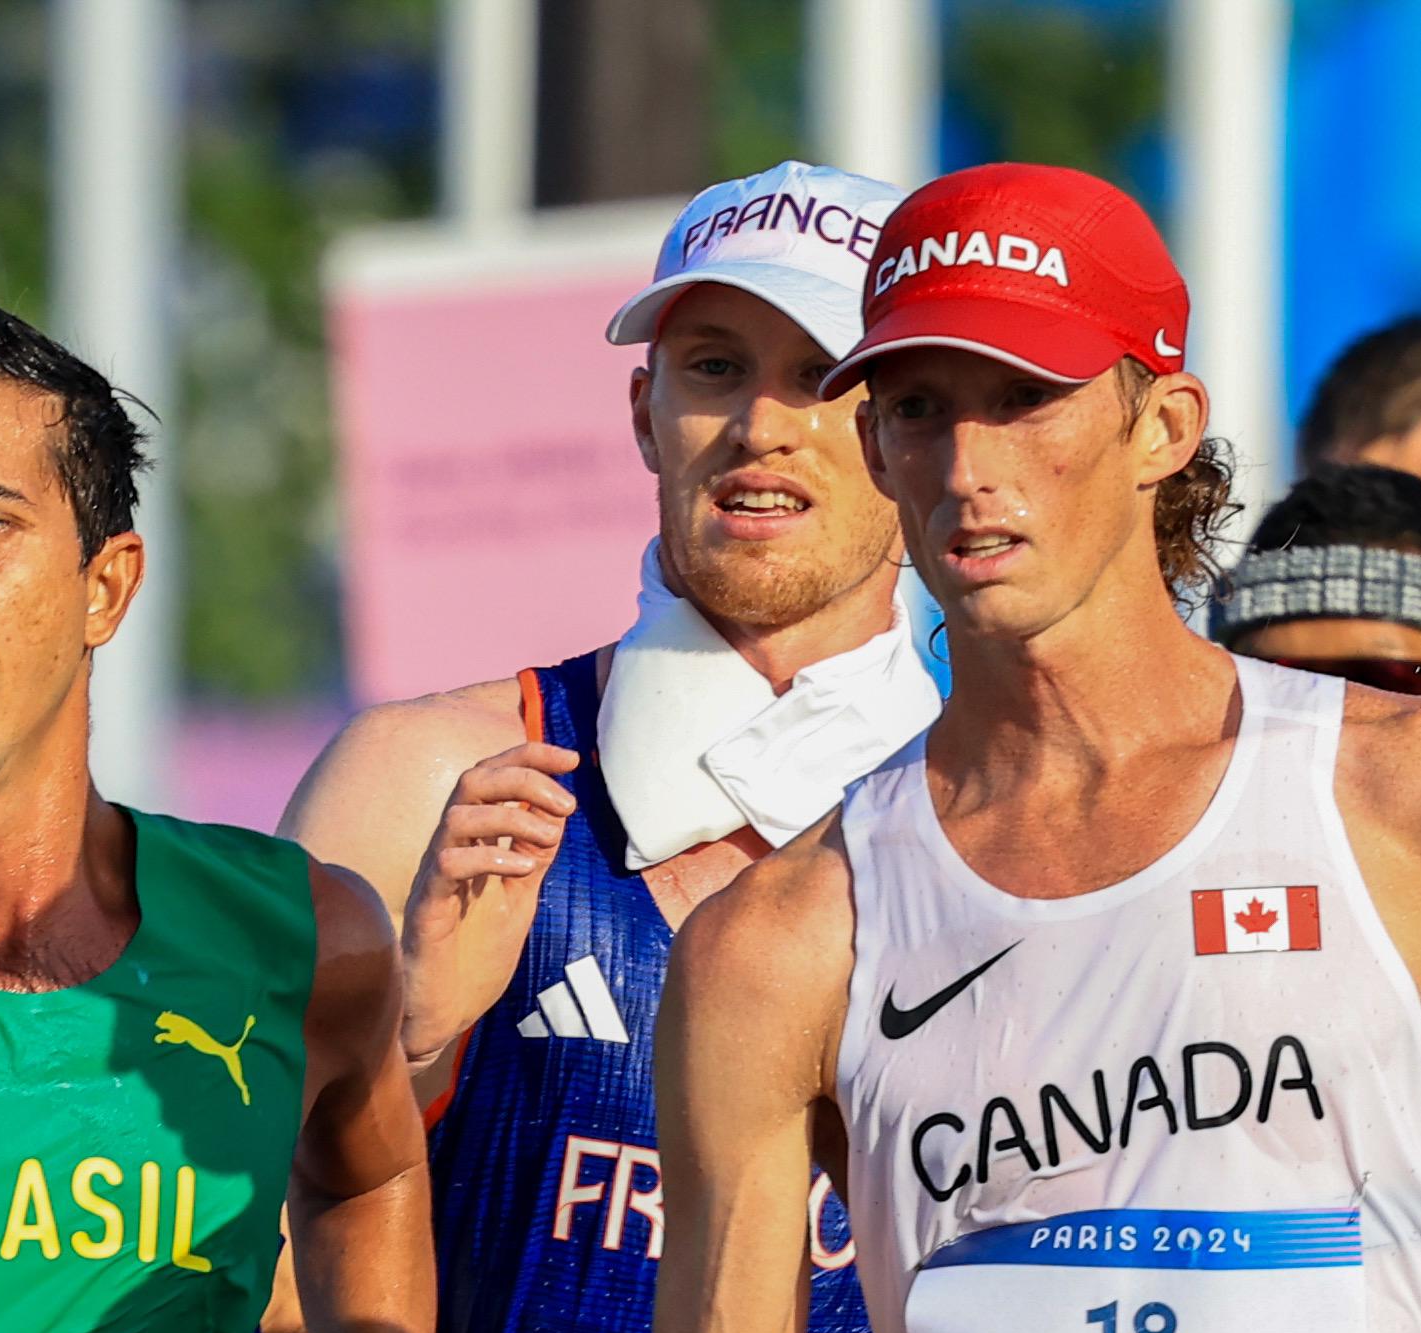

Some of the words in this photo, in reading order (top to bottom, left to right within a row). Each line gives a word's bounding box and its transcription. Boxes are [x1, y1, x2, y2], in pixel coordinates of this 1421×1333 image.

[681, 192, 881, 267] FRANCE
[874, 231, 1069, 297] CANADA
[911, 1035, 1324, 1202] CANADA
[1152, 1228, 1252, 1254] 2024
